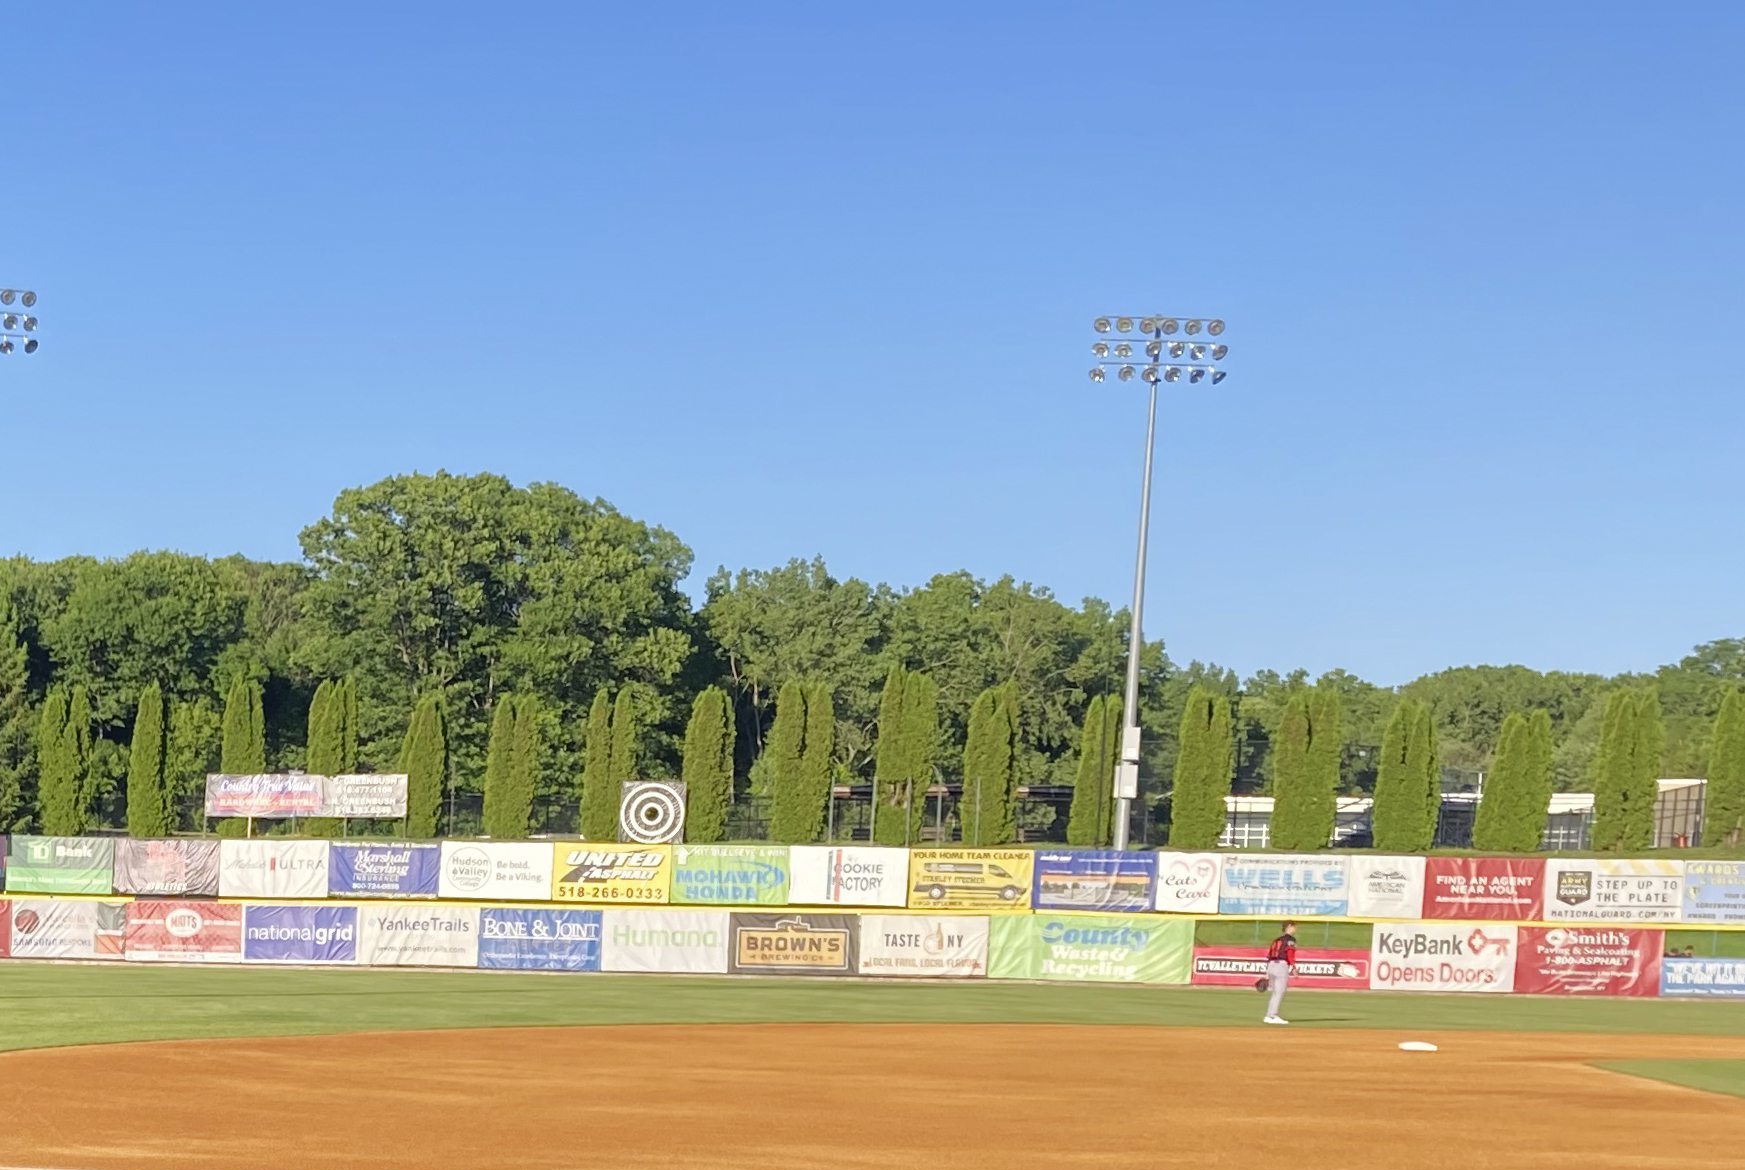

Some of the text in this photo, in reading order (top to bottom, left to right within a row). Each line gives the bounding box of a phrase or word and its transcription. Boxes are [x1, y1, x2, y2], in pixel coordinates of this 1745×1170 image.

[56, 845, 93, 858] Bank
[355, 850, 412, 865] Marshall
[967, 852, 991, 860] TEAM
[279, 859, 326, 870] ULTRA
[452, 857, 489, 867] Hudson
[496, 861, 508, 869] Be
[566, 851, 665, 867] UNITED
[458, 867, 488, 879] Valley
[588, 868, 658, 880] ASPHALT
[834, 863, 883, 874] COOKIE
[496, 873, 506, 881] Be
[1225, 868, 1345, 889] WELLS
[1436, 876, 1534, 887] FIND AN AGENT
[1561, 877, 1588, 885] ARMY
[832, 877, 884, 891] FACTORY
[1450, 885, 1484, 895] NEAR
[1596, 880, 1678, 890] STEP UP TO
[559, 886, 663, 899] 518-266-0333
[686, 886, 758, 900] HONDA
[1175, 888, 1211, 899] Care
[1559, 888, 1588, 896] GUARD
[1596, 892, 1668, 903] THE PLATE
[377, 917, 470, 932] YankeeTrails
[482, 917, 600, 941] BONE & JOINT
[248, 923, 354, 945] nationalgrid
[884, 933, 964, 948] TASTE NY
[1041, 922, 1150, 951] County
[1568, 931, 1631, 946] Smith's
[746, 937, 840, 953] BROWN'S
[1378, 932, 1464, 958] KeyBank
[1537, 945, 1641, 958] Paving & Sealcoating
[1051, 945, 1108, 961] Waste
[1040, 959, 1137, 979] Recycling
[1377, 961, 1435, 985] Opens
